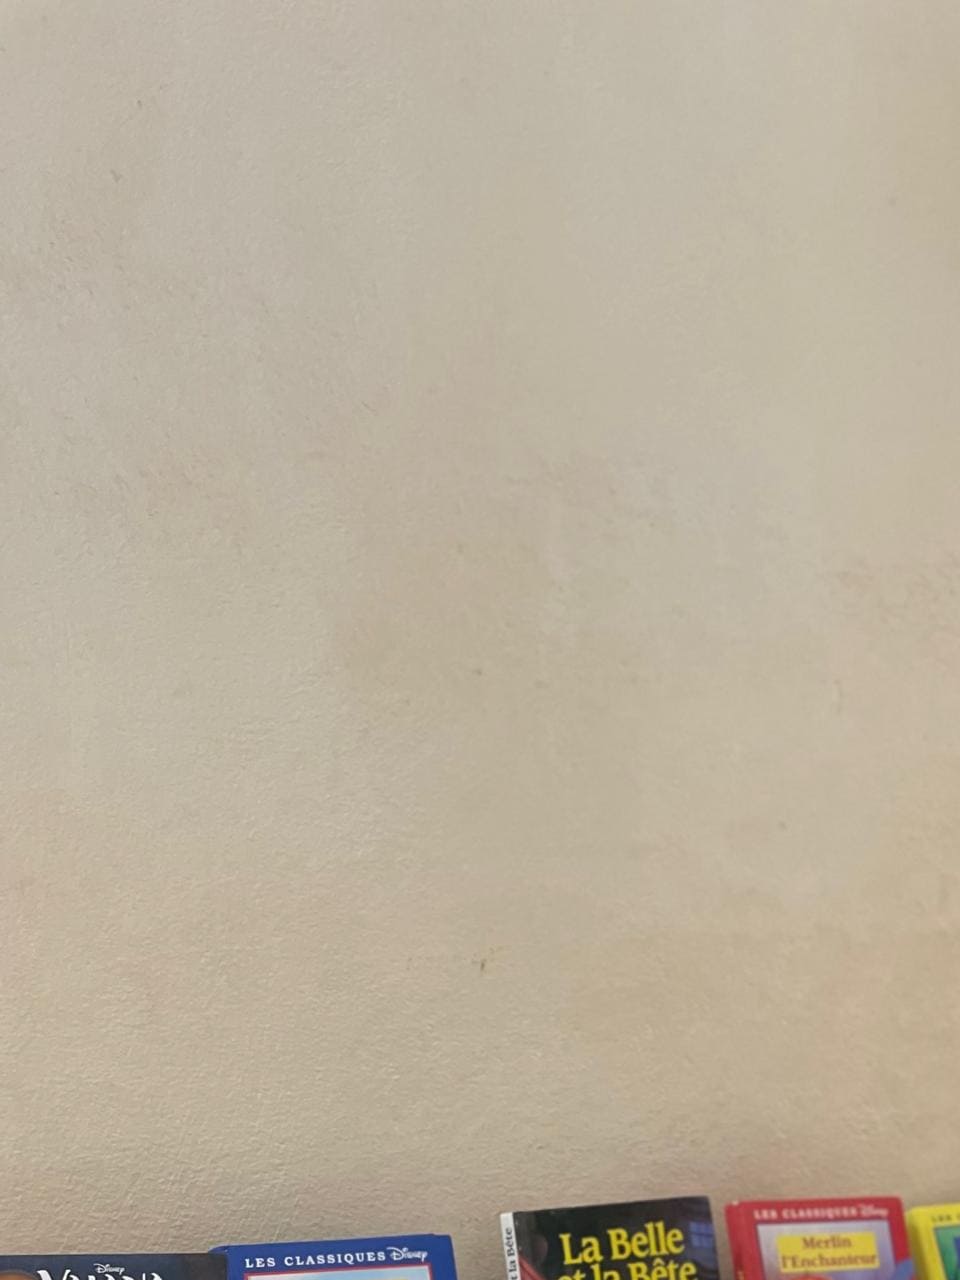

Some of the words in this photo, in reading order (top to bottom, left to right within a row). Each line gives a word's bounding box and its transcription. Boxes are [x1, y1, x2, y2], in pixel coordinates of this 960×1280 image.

[559, 1232, 603, 1265] La
[607, 1220, 685, 1261] Belle
[802, 1235, 853, 1249] Merlin
[245, 1257, 276, 1269] LES
[284, 1251, 386, 1267] CLASSIQUES
[386, 1247, 428, 1263] Disney
[93, 1263, 126, 1275] Disney
